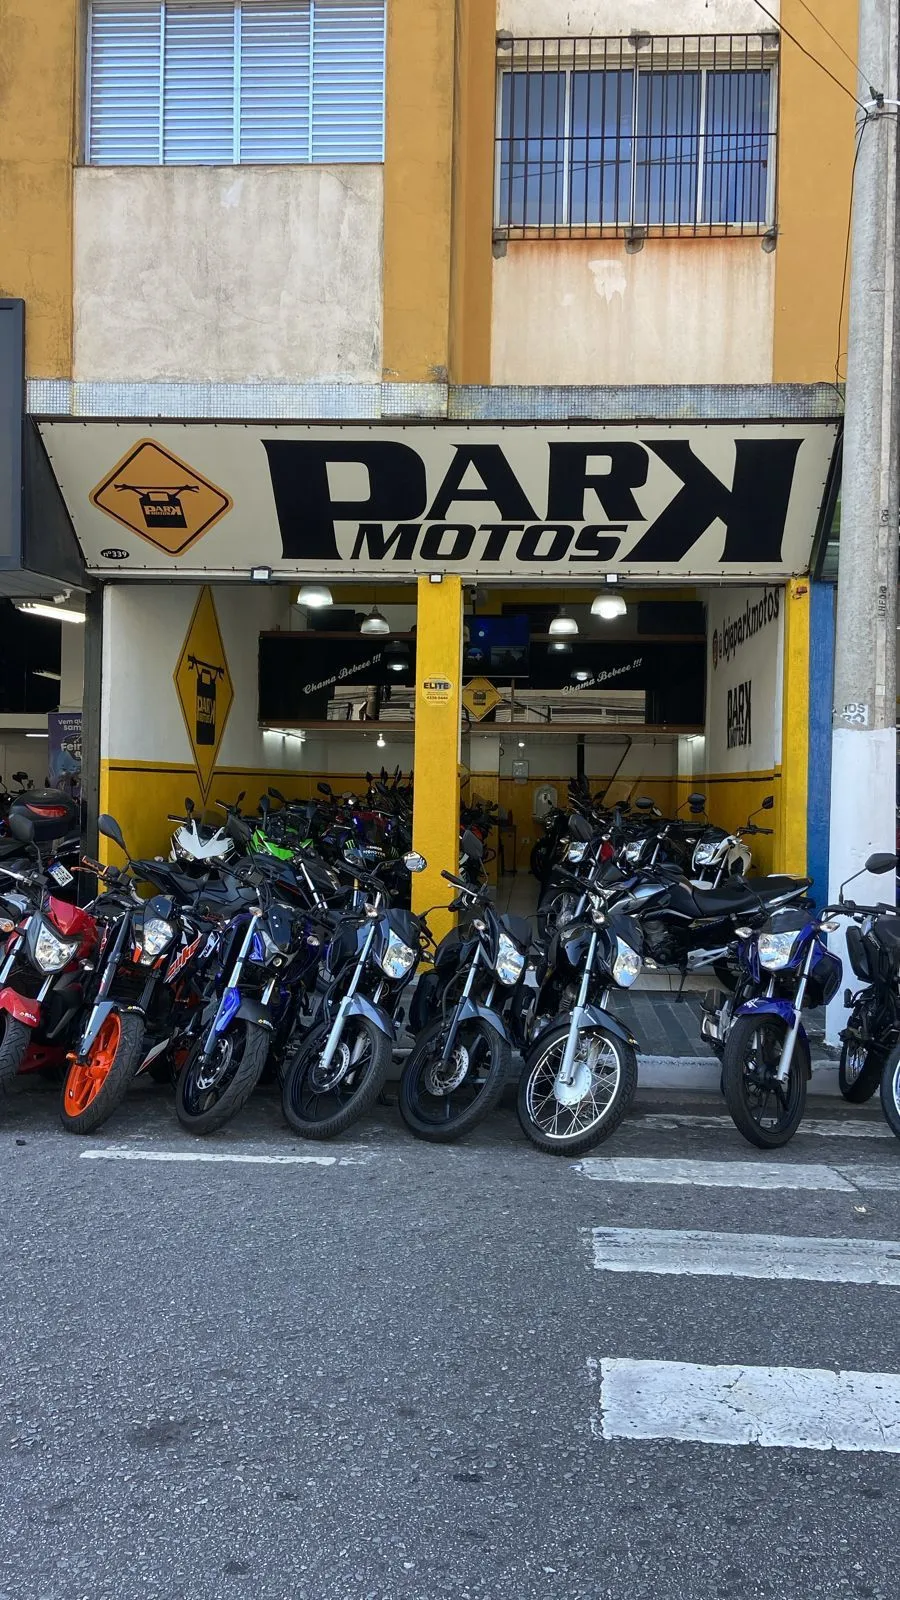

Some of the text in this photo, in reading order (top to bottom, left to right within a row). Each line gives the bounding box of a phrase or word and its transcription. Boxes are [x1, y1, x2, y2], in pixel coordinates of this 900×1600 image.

[144, 505, 183, 516] PARK
[260, 439, 805, 563] PARK
[350, 523, 629, 562] MOTOS
[303, 675, 337, 694] Chama
[560, 678, 596, 696] Chama
